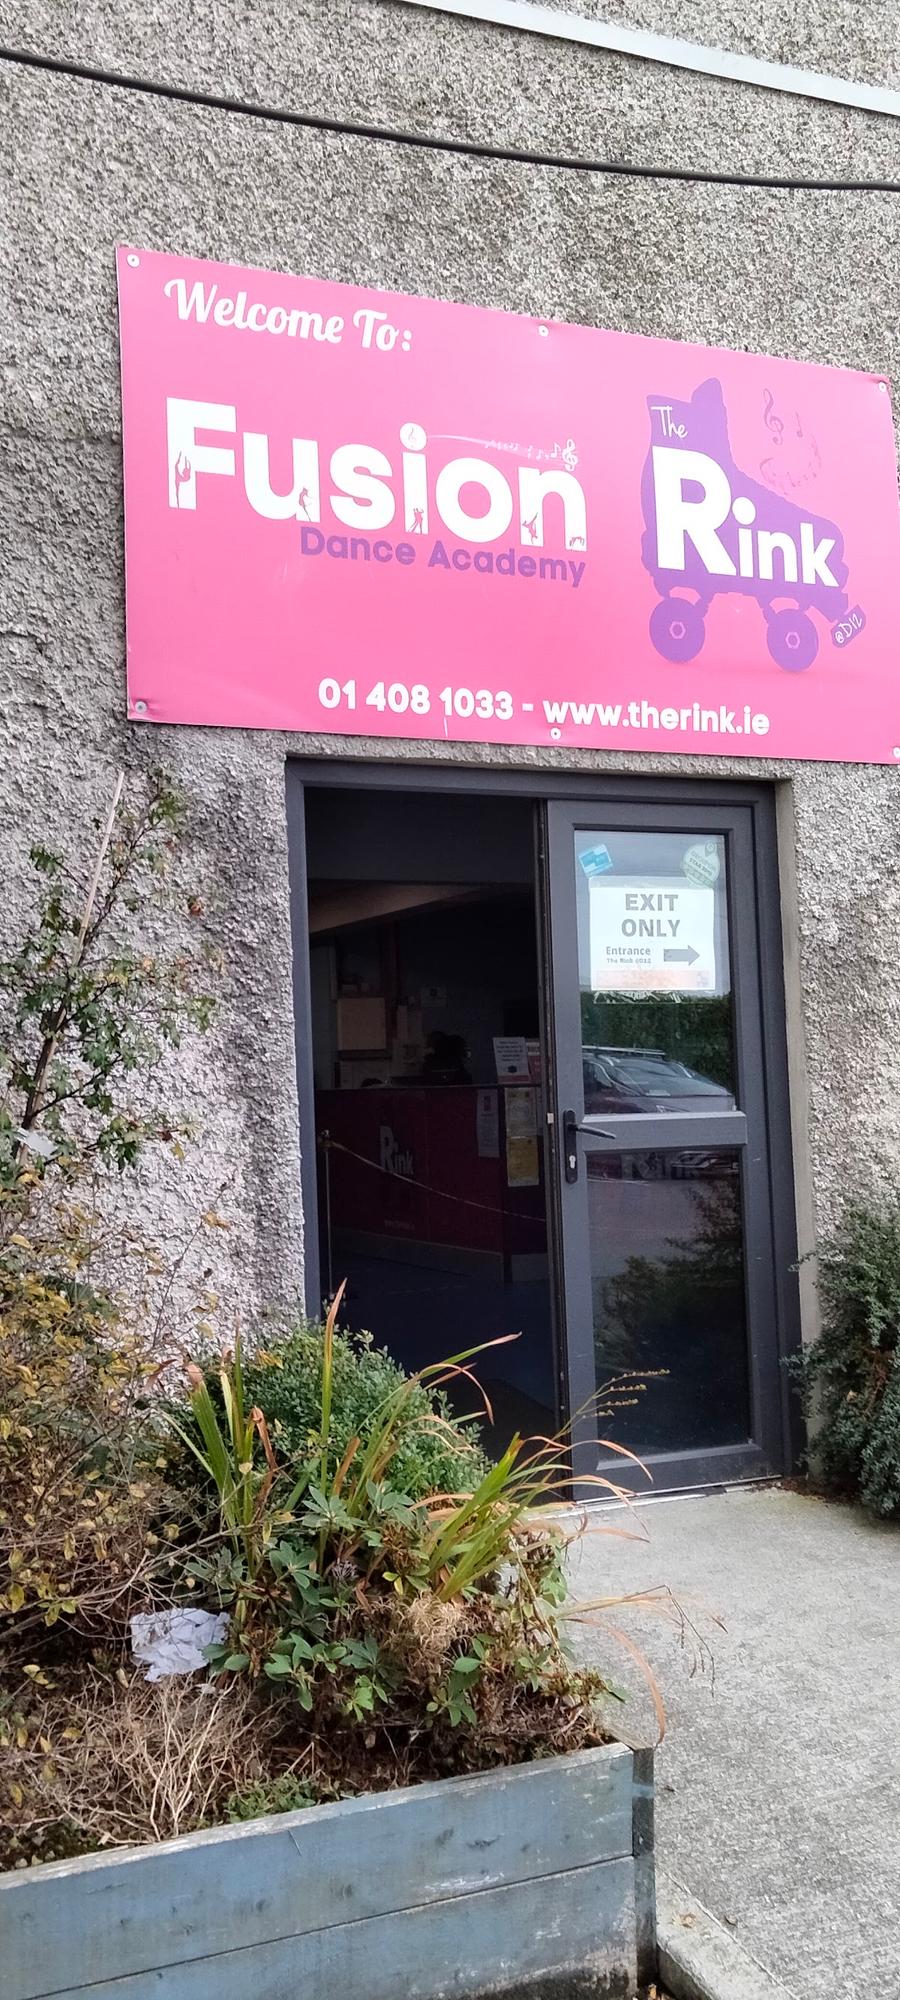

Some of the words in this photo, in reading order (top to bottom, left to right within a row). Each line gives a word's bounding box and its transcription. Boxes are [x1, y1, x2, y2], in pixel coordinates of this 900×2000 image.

[164, 278, 345, 344] Welcome
[353, 308, 412, 352] To:
[650, 405, 688, 438] The
[166, 397, 588, 552] Fusion
[652, 445, 840, 588] Rink
[300, 525, 416, 566] Dance
[428, 539, 587, 588] Academy
[834, 615, 863, 645] @D12
[318, 677, 356, 711] 01
[366, 680, 431, 715] 408
[440, 686, 514, 721] 1033
[544, 699, 770, 736] www.therink.ie
[625, 893, 679, 912] EXIT
[606, 945, 651, 956] Entrance
[621, 918, 681, 938] ONLY
